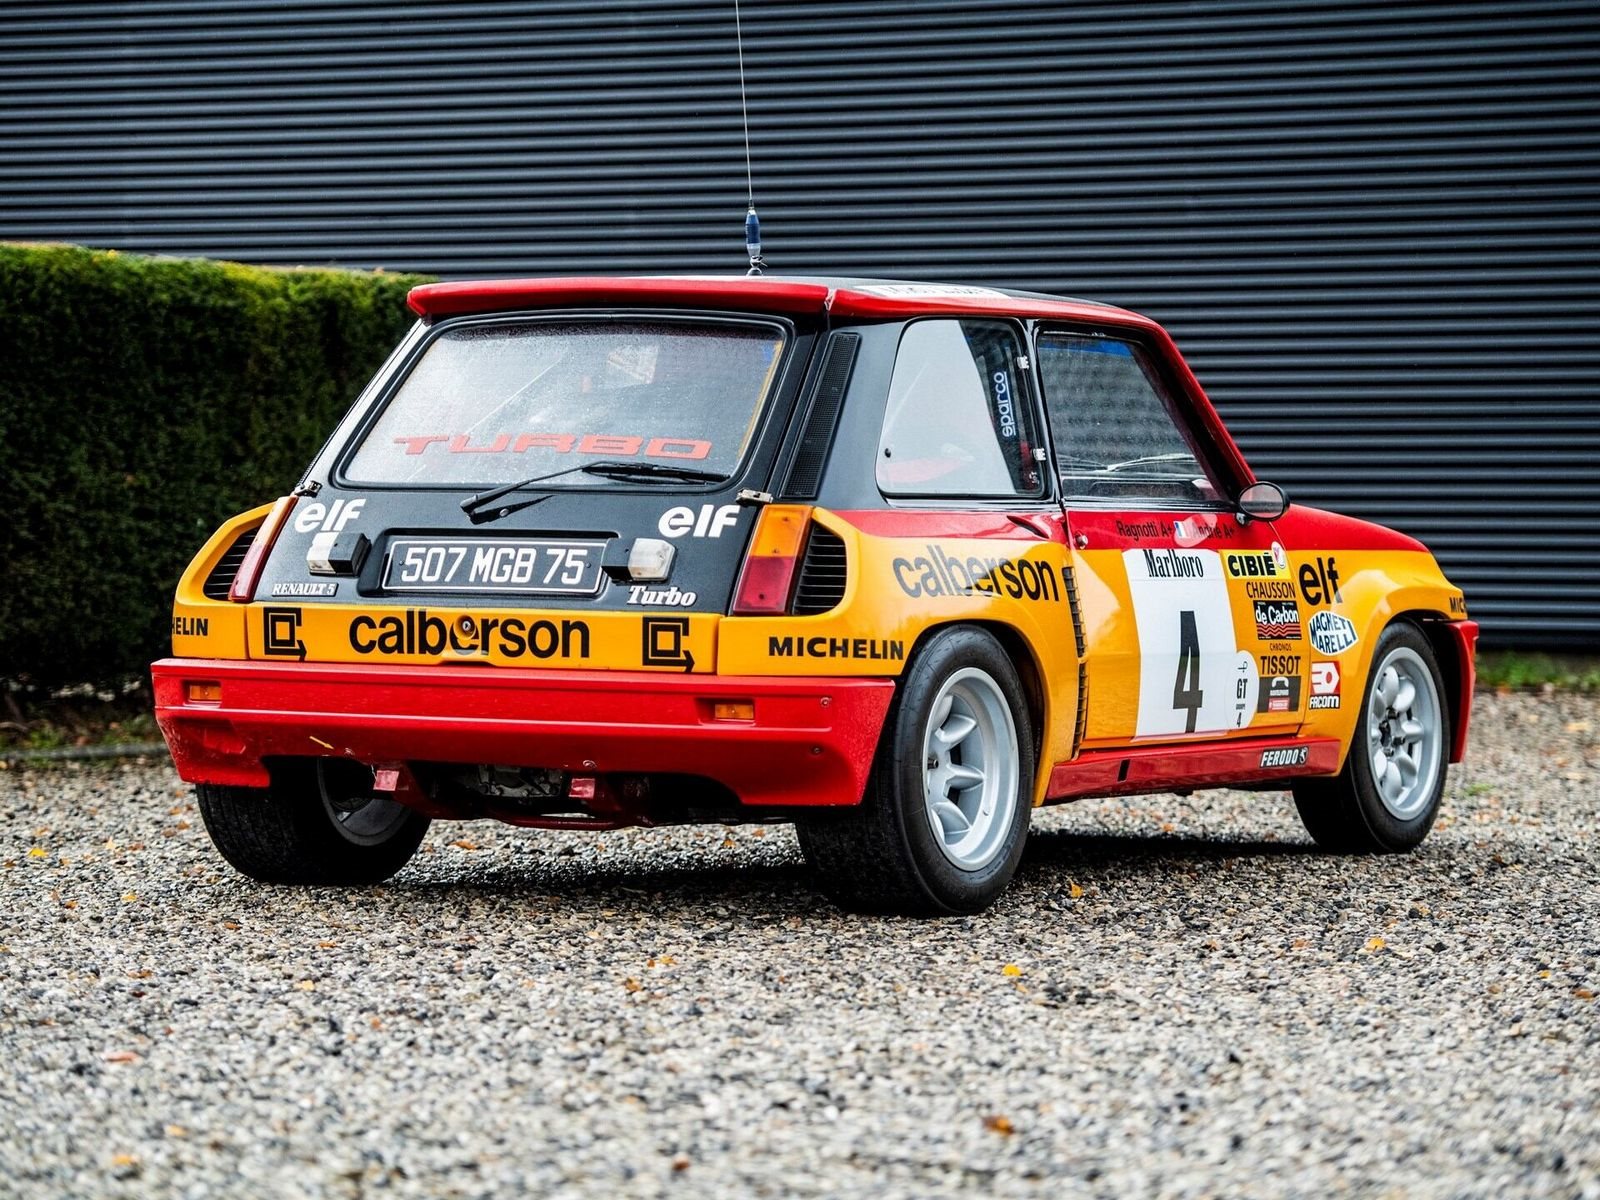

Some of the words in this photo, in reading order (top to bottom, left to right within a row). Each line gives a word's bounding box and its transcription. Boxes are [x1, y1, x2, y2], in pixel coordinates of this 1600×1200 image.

[994, 371, 1016, 437] sparco
[393, 434, 712, 460] TURBO
[294, 499, 366, 532] elf
[658, 504, 741, 538] elf
[1116, 520, 1159, 541] Ragnotti
[401, 547, 467, 582] 507
[469, 547, 536, 583] MGB
[543, 549, 588, 585] 75
[893, 544, 1059, 601] calberson
[1143, 549, 1204, 579] Marlboro
[272, 583, 326, 596] RENAULT
[327, 583, 336, 596] 5
[1246, 581, 1296, 599] CHAUSSON
[1299, 557, 1342, 605] elf
[627, 585, 697, 606] Turbo
[1256, 605, 1267, 625] de
[1268, 605, 1299, 625] Carbon
[349, 608, 589, 659] calberson
[768, 636, 904, 660] MICHELIN
[1269, 643, 1292, 651] CHRONOS
[1173, 610, 1203, 733] 4
[1260, 655, 1301, 675] TISSOT
[1236, 678, 1248, 699] GT
[1236, 712, 1242, 727] 4
[1260, 749, 1299, 767] FERODO
